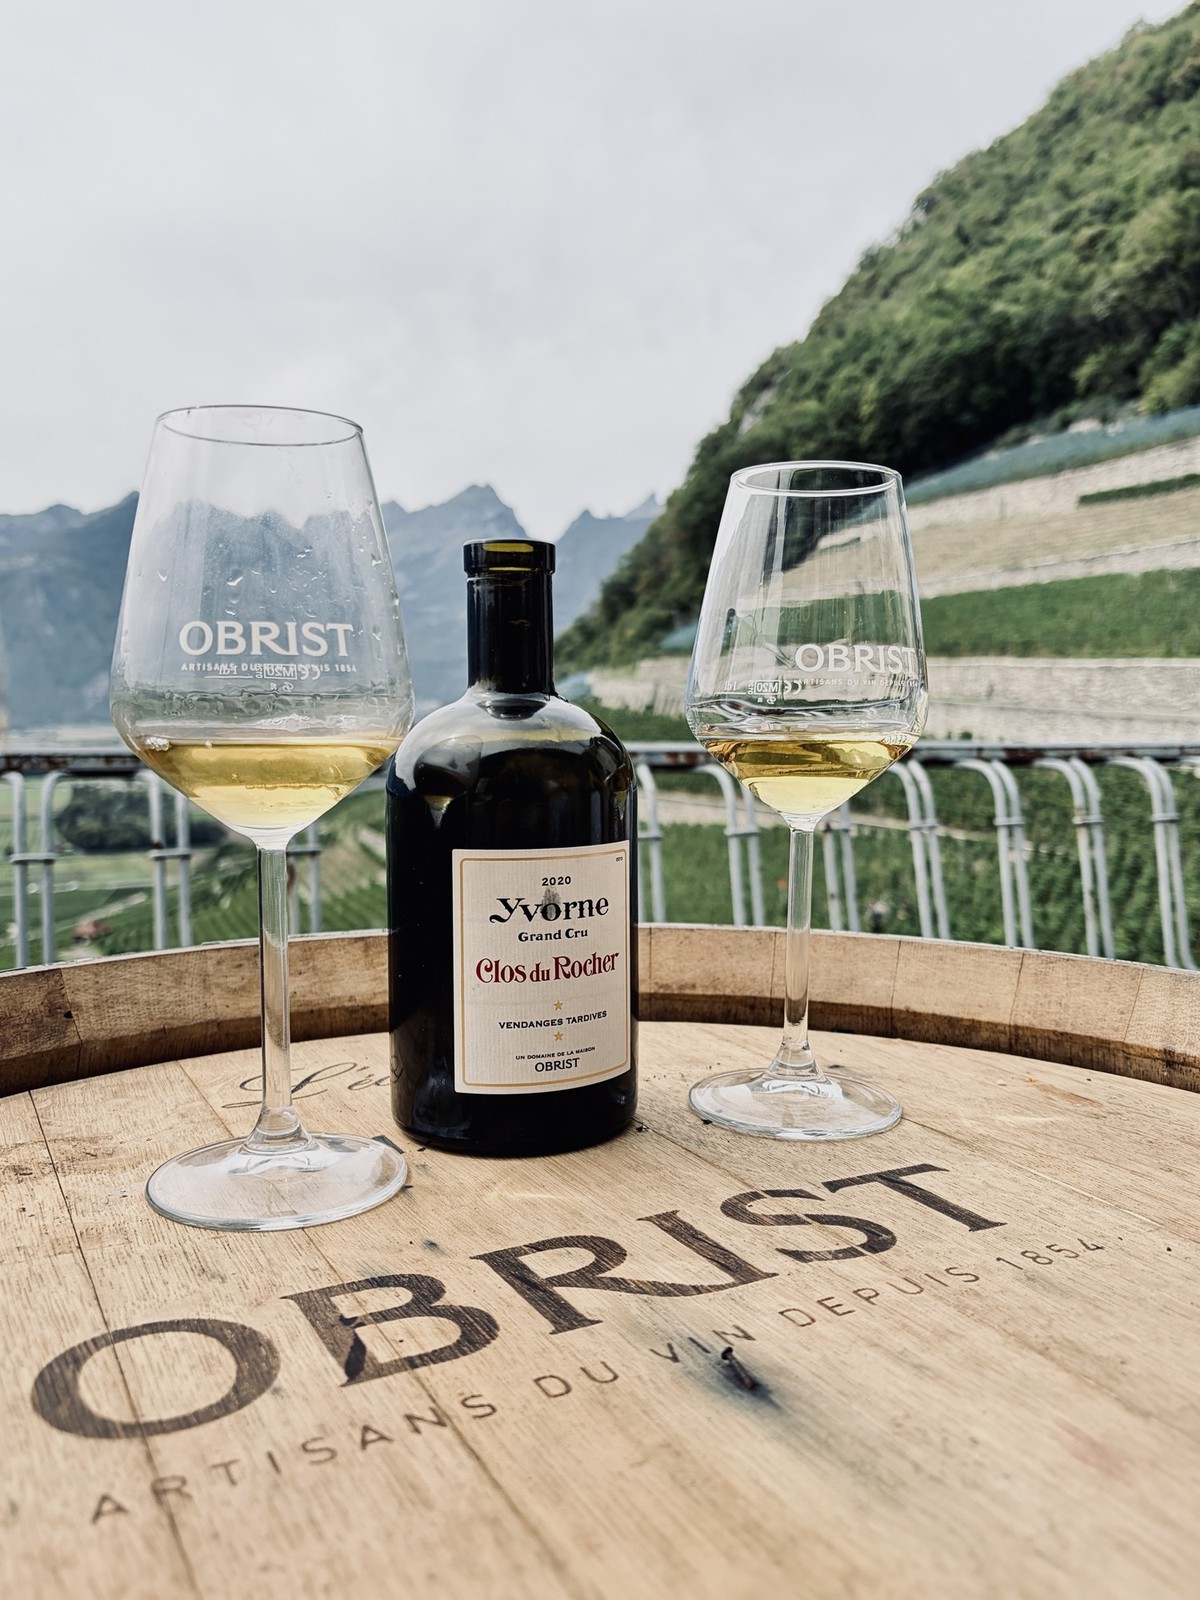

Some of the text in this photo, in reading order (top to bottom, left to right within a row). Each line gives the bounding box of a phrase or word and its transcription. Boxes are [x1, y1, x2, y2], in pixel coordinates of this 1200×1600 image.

[179, 620, 354, 657] OBRIST
[334, 663, 357, 673] 1854
[795, 643, 919, 681] OBRIST
[541, 876, 571, 886] 2020
[489, 897, 609, 924] Yvorne
[518, 928, 588, 942] Grand Cru
[476, 951, 619, 983] Clos du Rocher
[498, 1010, 608, 1030] VENDANGES TARDIVES
[527, 1052, 556, 1060] DOMAINE
[575, 1046, 596, 1054] MAISON
[534, 1057, 580, 1073] OBRIST
[30, 1162, 1007, 1440] OBRIST
[90, 1237, 1105, 1525] ARTISANS DU VIN DEPUIS 1854
